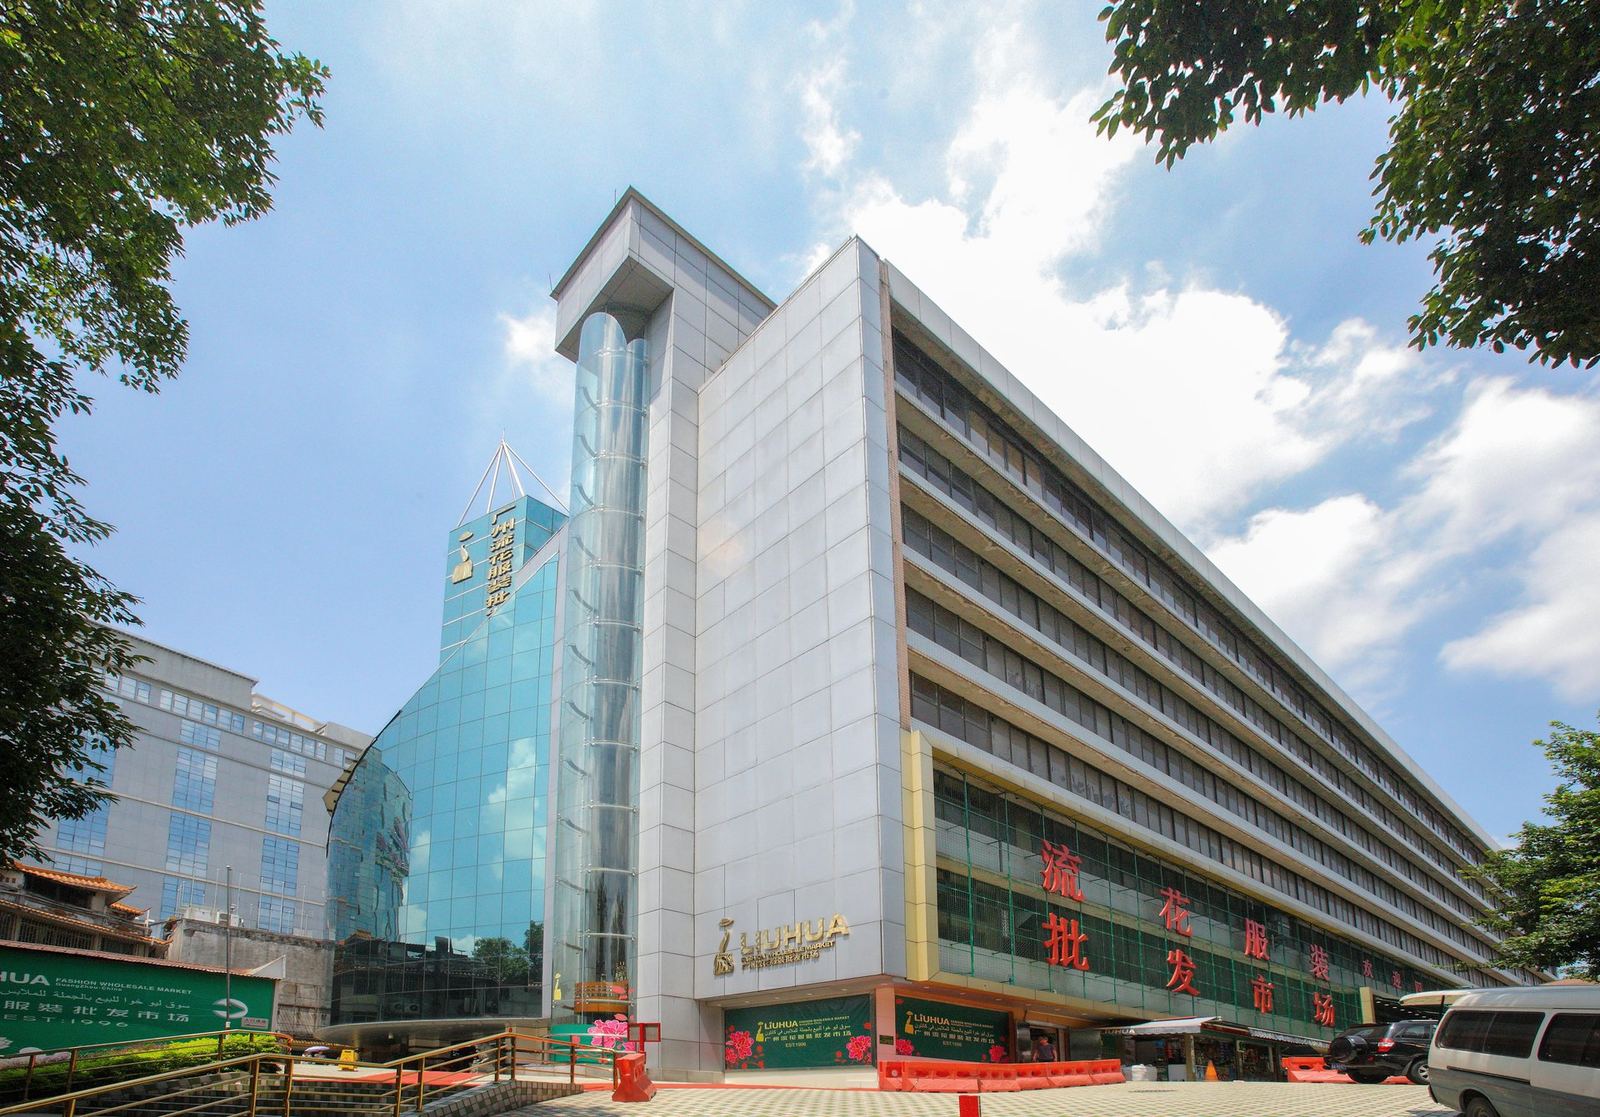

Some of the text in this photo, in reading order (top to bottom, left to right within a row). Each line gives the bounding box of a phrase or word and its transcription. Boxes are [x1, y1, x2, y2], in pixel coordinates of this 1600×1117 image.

[485, 504, 516, 619] 广州流花服装批
[740, 912, 850, 955] LIUHUA
[1040, 838, 1331, 982] 流花服装
[55, 977, 193, 995] FASHION WHOLESALE MARKET
[1042, 911, 1336, 1028] 批发市场
